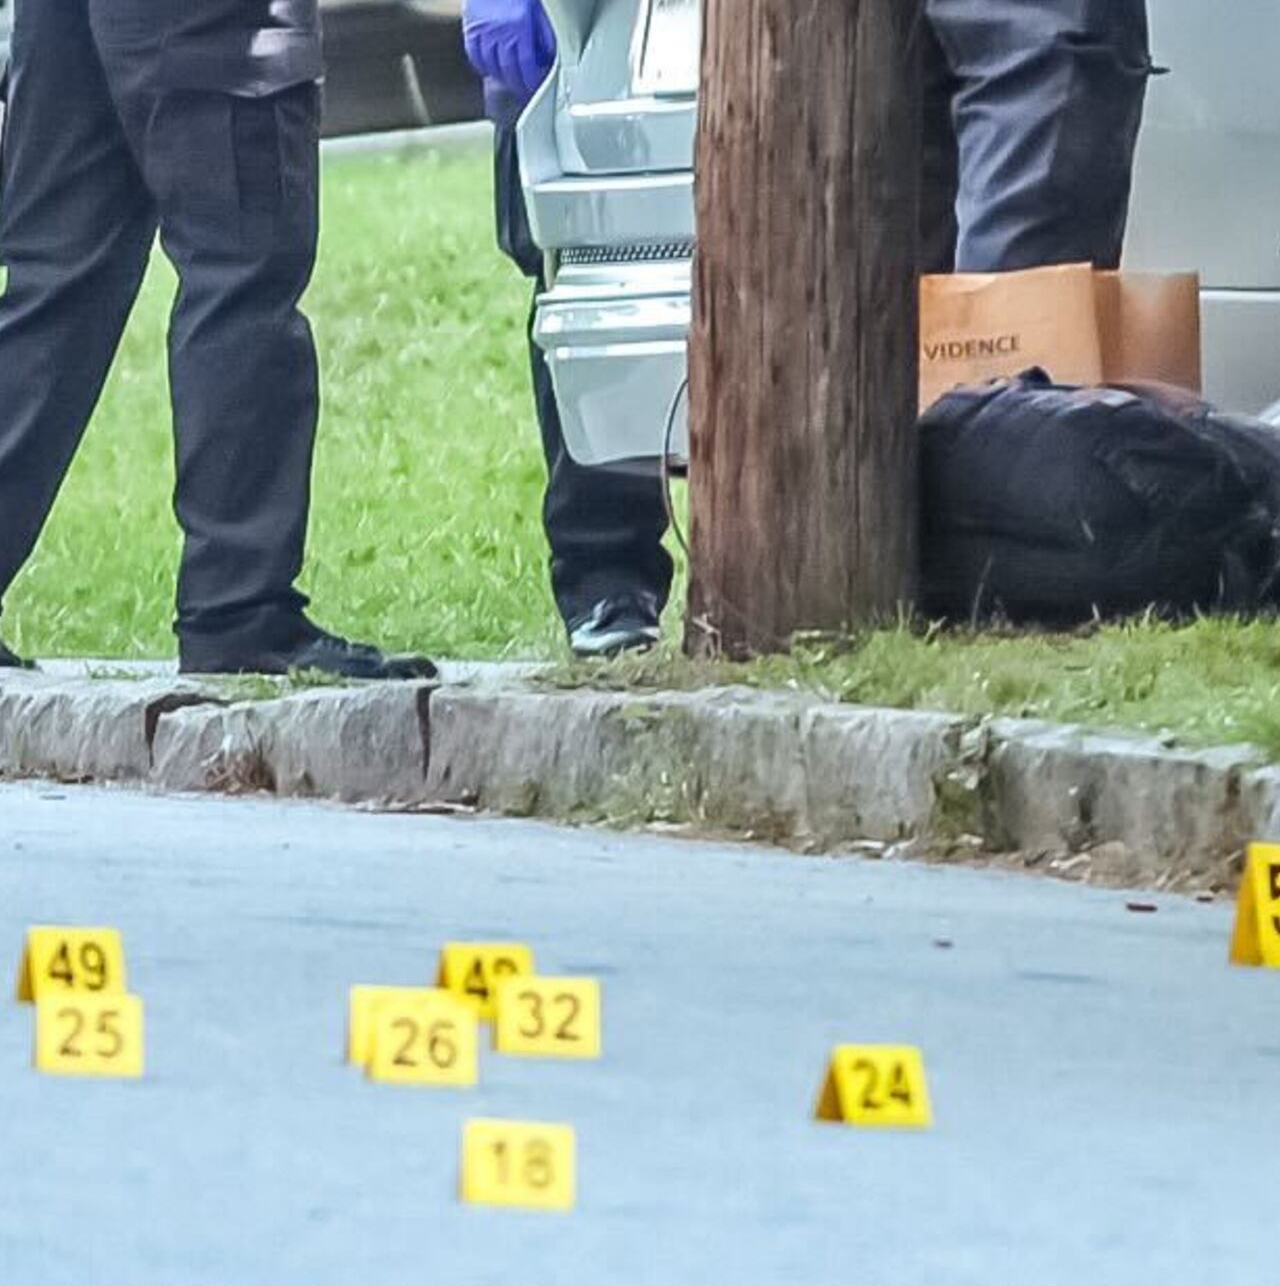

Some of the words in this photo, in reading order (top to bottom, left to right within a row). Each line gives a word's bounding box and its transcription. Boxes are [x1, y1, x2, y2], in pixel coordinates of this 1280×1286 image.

[923, 334, 1021, 361] VIDENCE
[46, 940, 108, 993] 49
[55, 1007, 124, 1060] 25
[518, 989, 582, 1042] 32
[390, 1016, 458, 1069] 26
[851, 1057, 912, 1111] 24
[488, 1137, 556, 1191] 18
